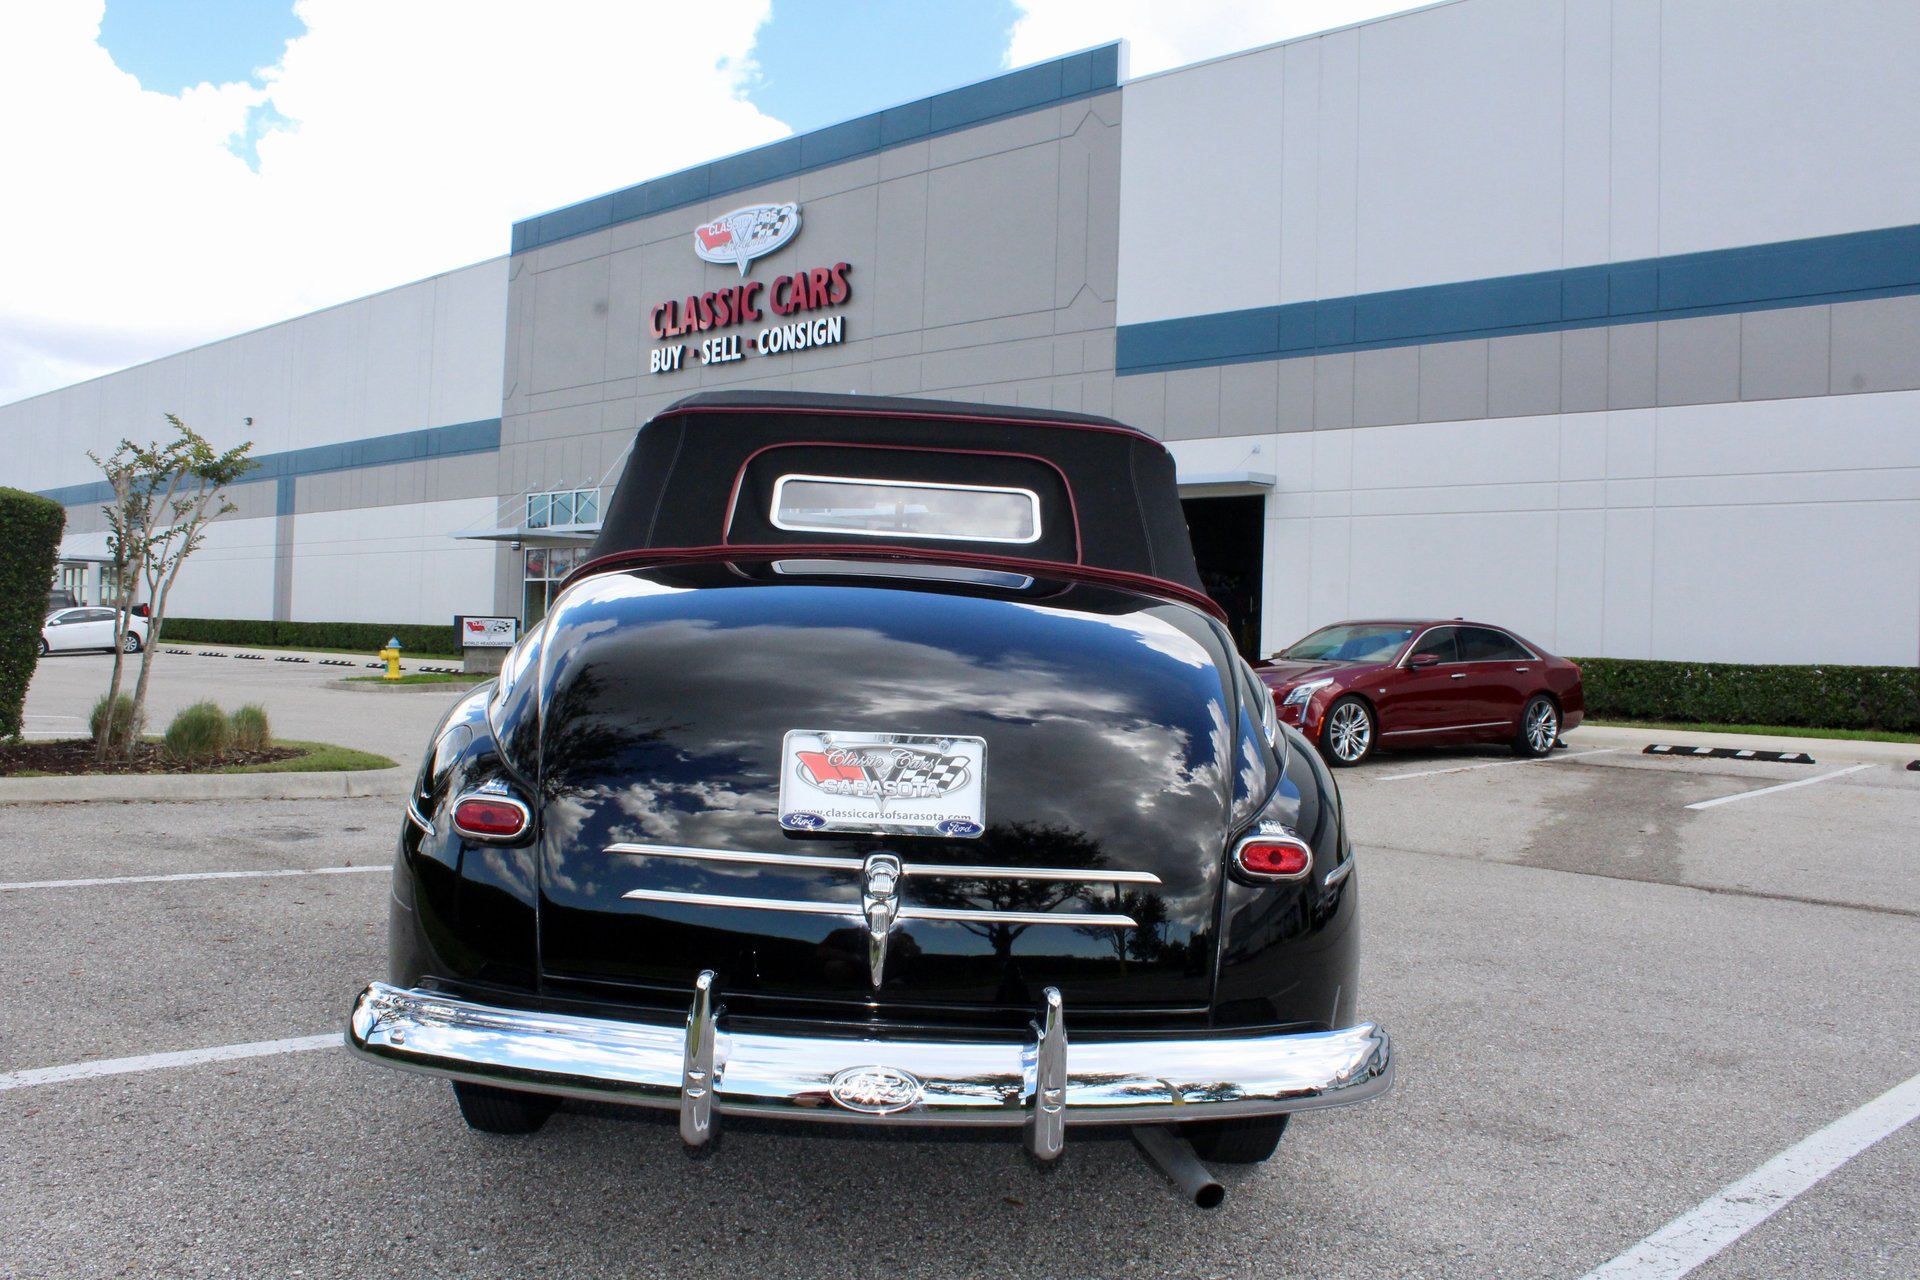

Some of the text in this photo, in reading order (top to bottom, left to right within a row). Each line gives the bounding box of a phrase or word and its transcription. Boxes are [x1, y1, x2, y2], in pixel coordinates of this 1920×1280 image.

[649, 261, 849, 340] CLASSIC CARS
[650, 315, 843, 373] BUY SELL CONSIGN
[824, 747, 936, 770] Classic Cars
[823, 778, 943, 799] SARASOTA
[790, 814, 816, 826] Ford
[947, 821, 973, 833] Ford
